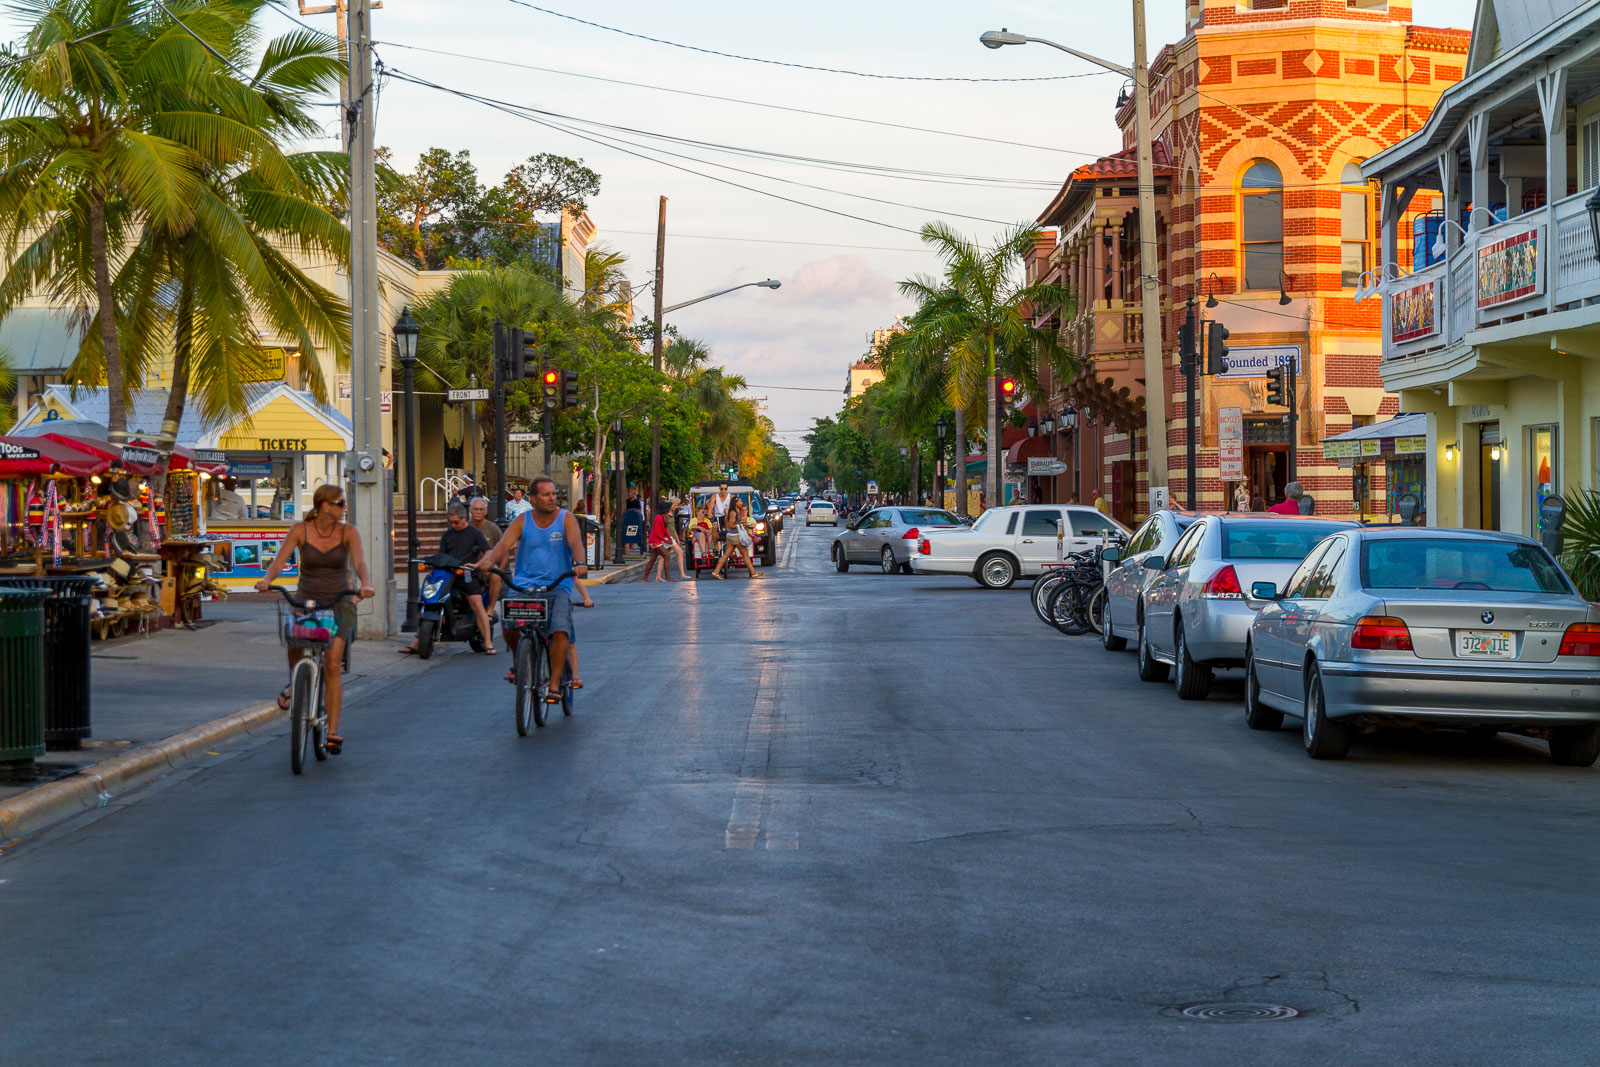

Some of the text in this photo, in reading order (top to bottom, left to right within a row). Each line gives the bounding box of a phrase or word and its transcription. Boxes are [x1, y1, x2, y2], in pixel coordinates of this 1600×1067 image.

[452, 390, 485, 399] FRONT ST
[1220, 415, 1240, 424] BICYCLES
[259, 438, 307, 450] TICKETS
[1462, 637, 1509, 651] 372 TIE
